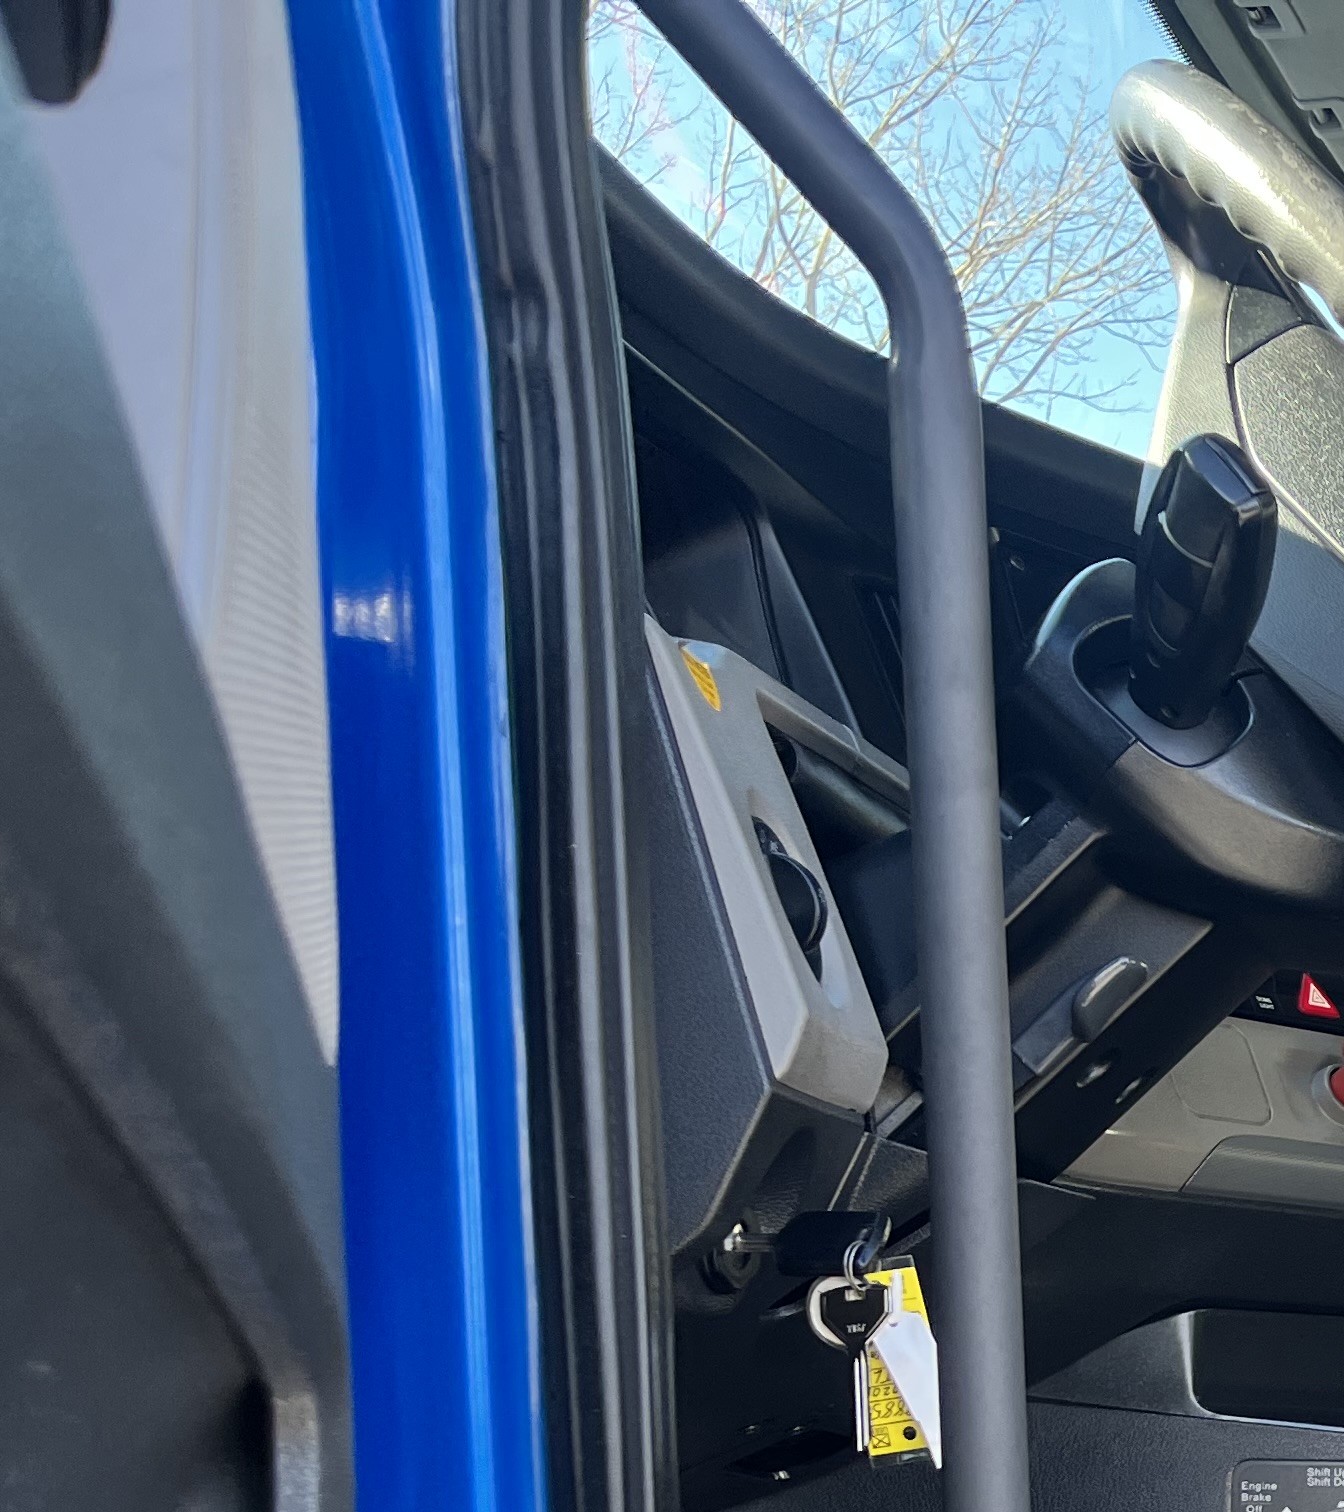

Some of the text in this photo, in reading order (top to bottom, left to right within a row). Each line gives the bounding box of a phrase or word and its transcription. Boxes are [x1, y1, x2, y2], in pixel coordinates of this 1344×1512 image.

[1306, 1467, 1331, 1477] Shift
[1241, 1480, 1278, 1492] Engine
[1306, 1477, 1331, 1486] Shift
[1241, 1493, 1272, 1502] Brake
